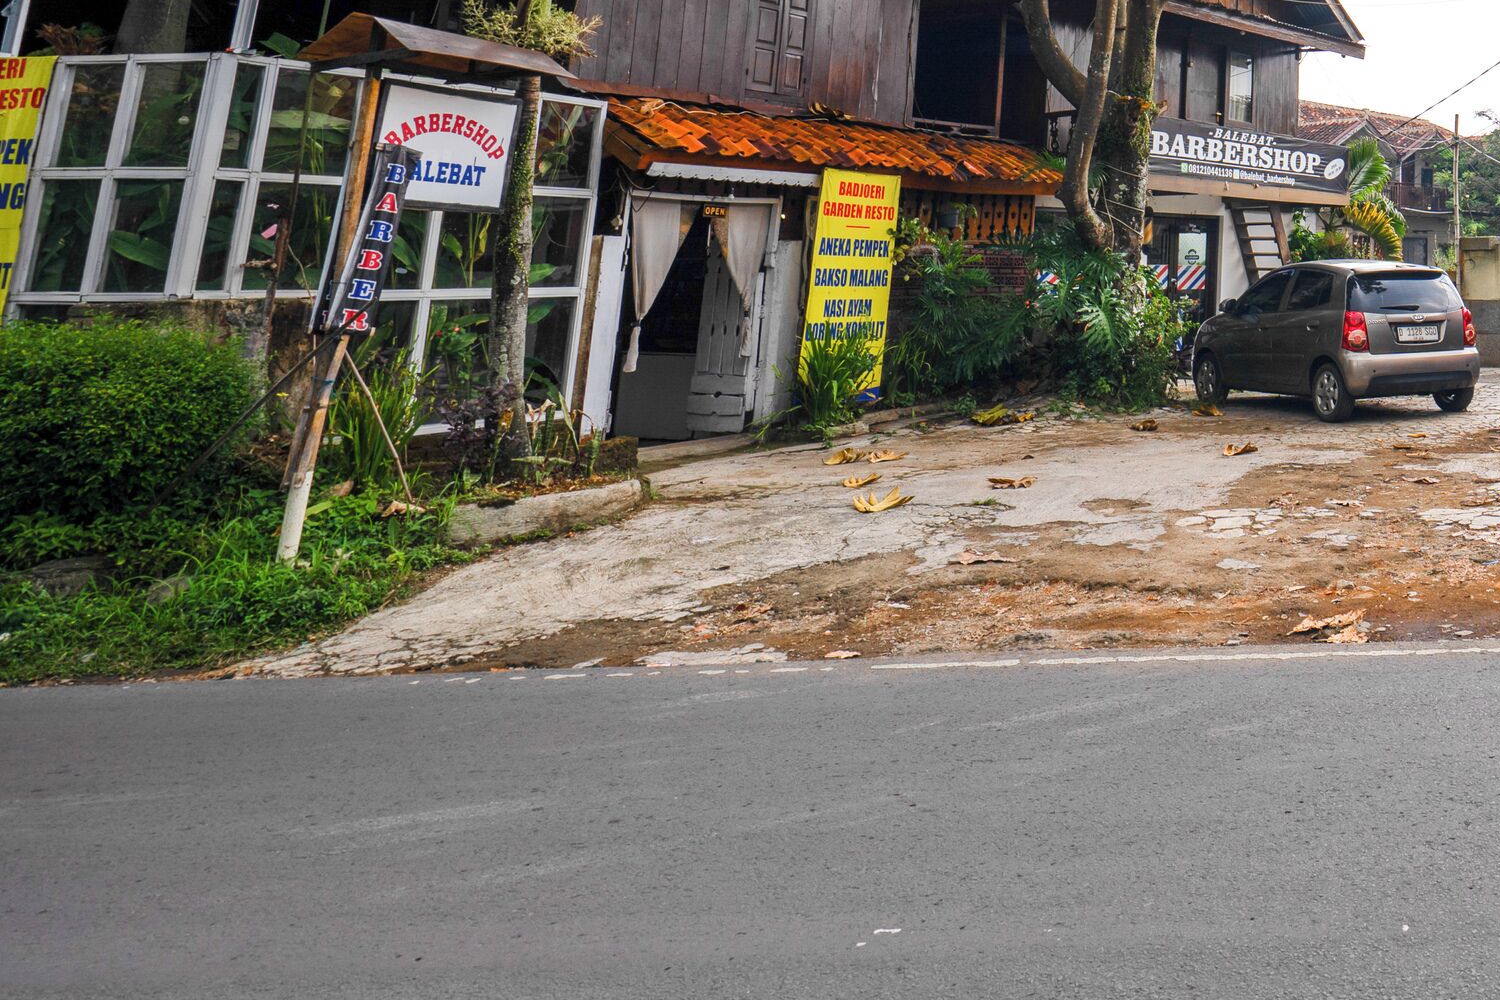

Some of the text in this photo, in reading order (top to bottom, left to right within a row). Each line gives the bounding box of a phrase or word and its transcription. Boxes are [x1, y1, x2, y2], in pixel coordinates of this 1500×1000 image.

[384, 112, 505, 161] BARBERSHOP
[1150, 130, 1322, 175] BARBERSHOP
[409, 159, 487, 187] ALEBAT
[838, 181, 885, 200] BADJOERI
[704, 206, 726, 216] OPEN
[823, 200, 895, 221] GARDEN RESTO
[338, 163, 407, 331] BARBER
[818, 236, 889, 258] ANEKA PEMPEK
[814, 268, 888, 287] BAKSO MALANG
[823, 299, 873, 318] NASI AYAM
